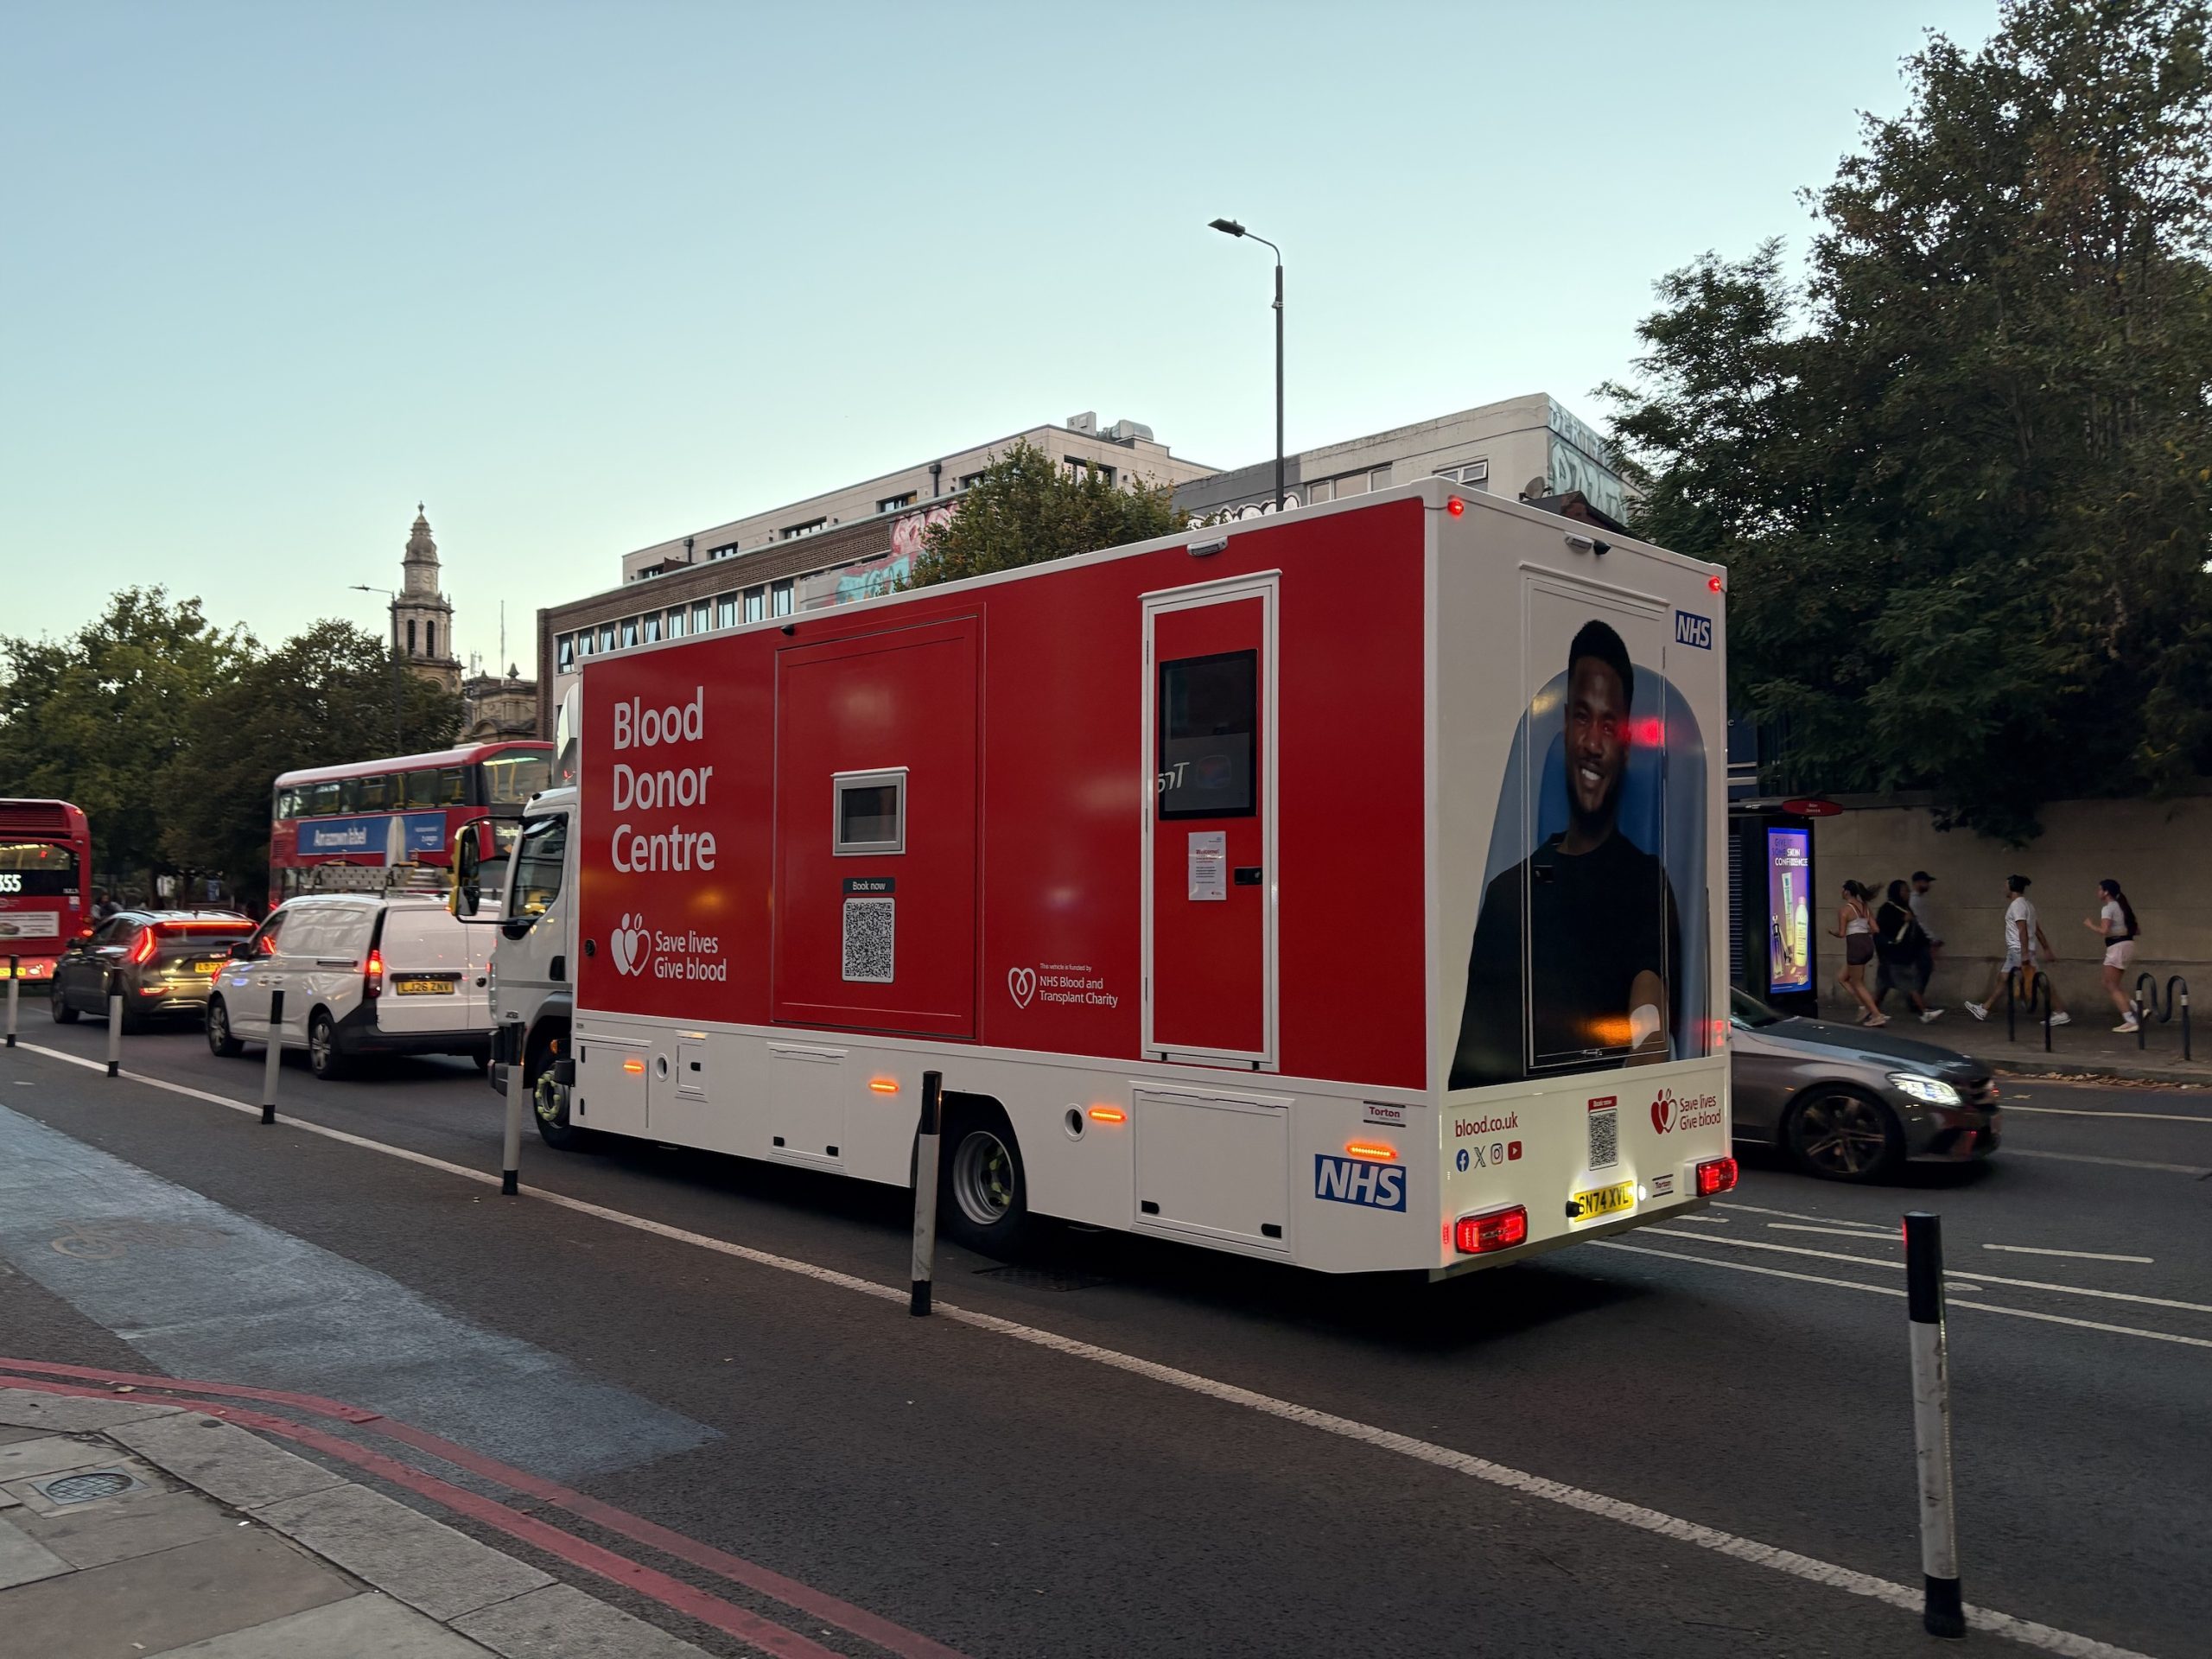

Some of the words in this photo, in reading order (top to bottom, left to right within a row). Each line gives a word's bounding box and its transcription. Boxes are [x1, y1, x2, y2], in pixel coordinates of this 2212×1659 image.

[1677, 615, 1710, 646] NHS
[613, 686, 704, 750] Blood
[613, 764, 713, 811] Donor
[612, 823, 716, 873] Centre
[852, 880, 869, 891] Book
[870, 882, 887, 891] now
[655, 930, 686, 953] Save
[689, 930, 719, 954] lives
[654, 956, 684, 980] Give
[686, 957, 727, 982] blood
[1039, 976, 1058, 988] NHS
[1059, 976, 1084, 988] Blood
[1086, 978, 1103, 989] and
[1039, 989, 1084, 1005] Transplant
[1085, 992, 1118, 1008] Charity
[1369, 1106, 1401, 1118] Torton
[1680, 1097, 1699, 1113] Save
[1700, 1094, 1717, 1109] lives
[1455, 1111, 1518, 1138] blood.co.uk
[1680, 1115, 1698, 1131] Give
[1699, 1109, 1721, 1127] blood
[1317, 1159, 1404, 1207] NHS
